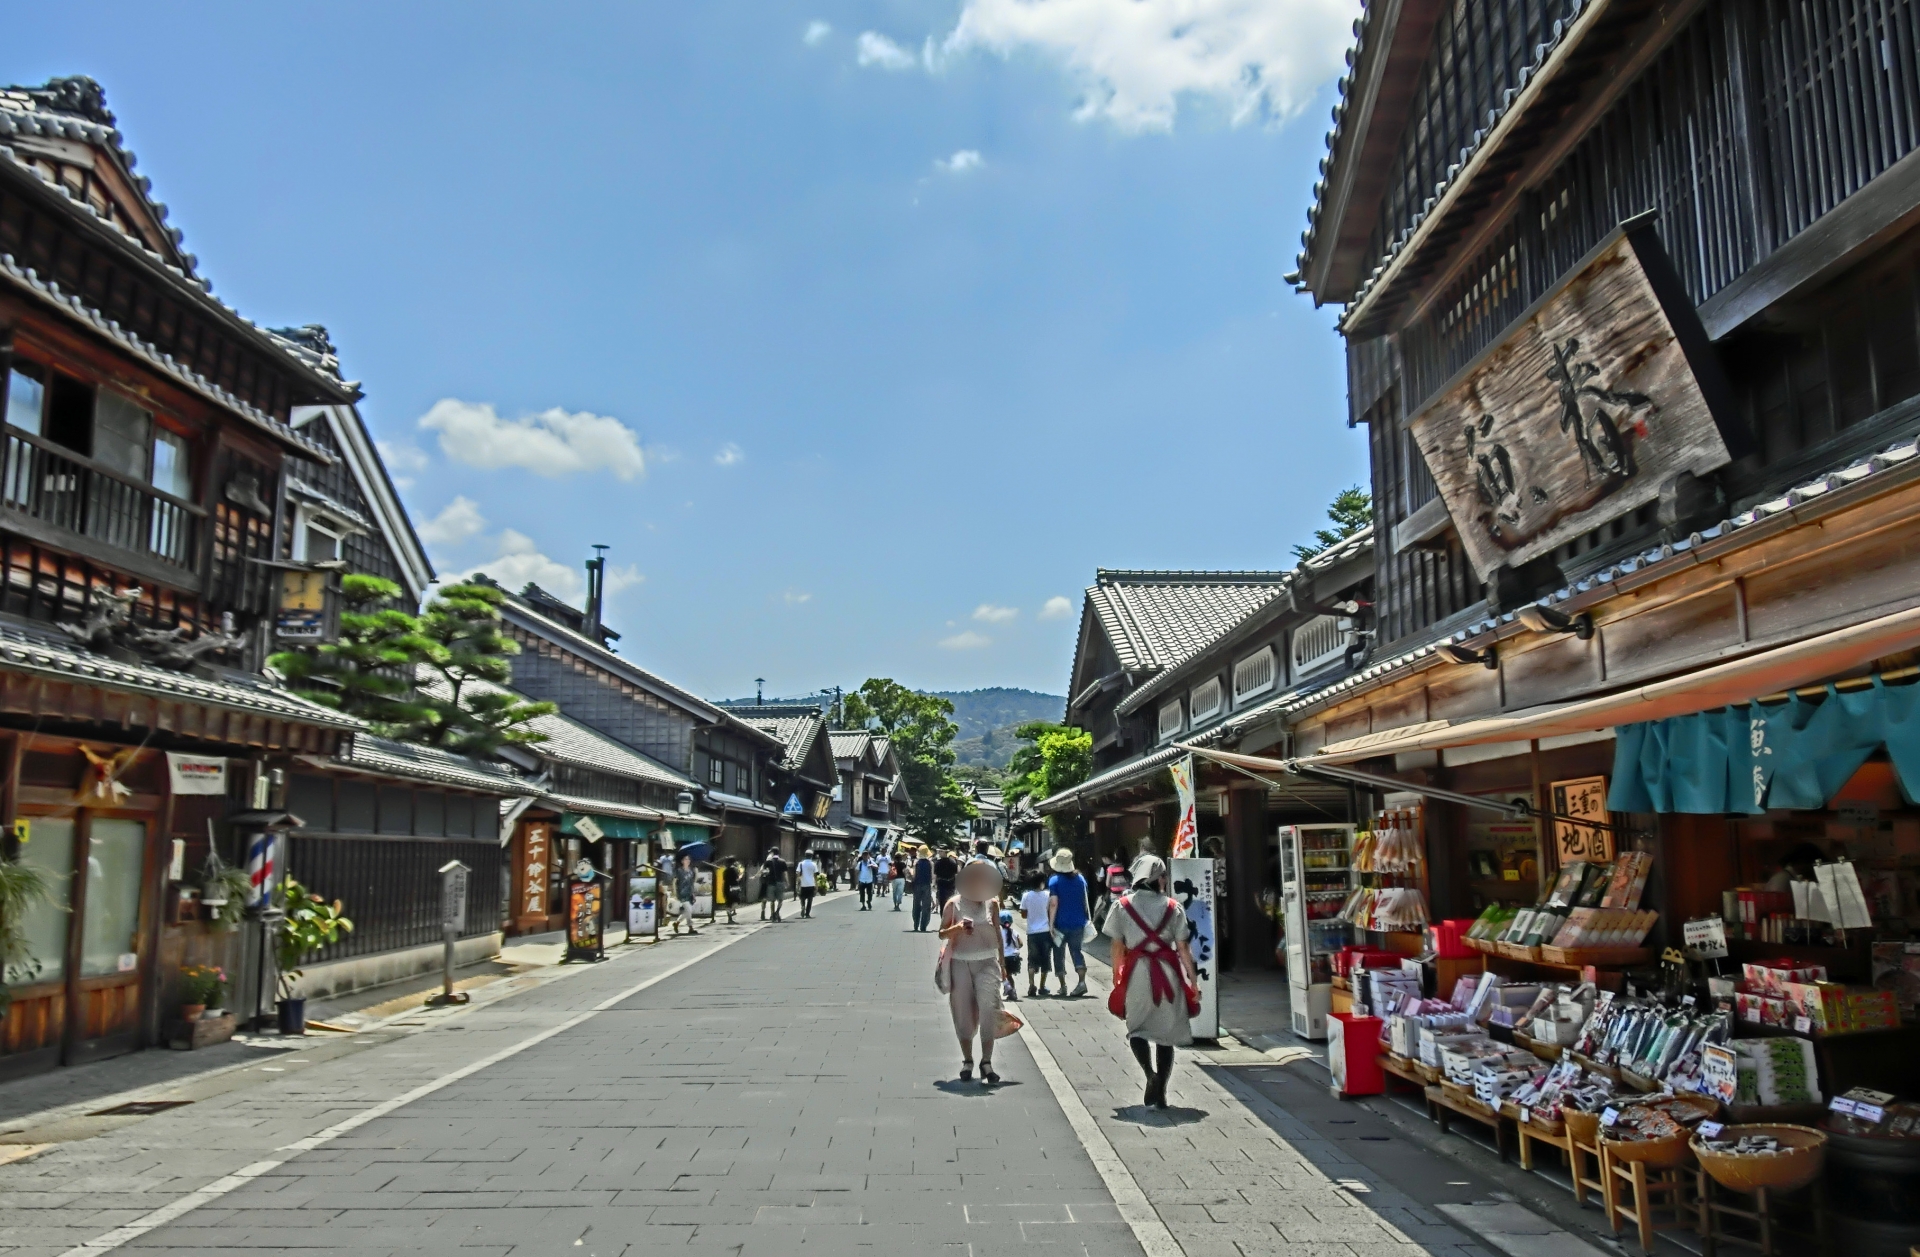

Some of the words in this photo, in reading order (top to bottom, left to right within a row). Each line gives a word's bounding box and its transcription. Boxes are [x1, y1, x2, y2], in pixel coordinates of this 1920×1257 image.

[1569, 788, 1599, 816] 三重の
[1561, 824, 1606, 859] 地酒
[525, 828, 545, 913] 五十鈴茶屋
